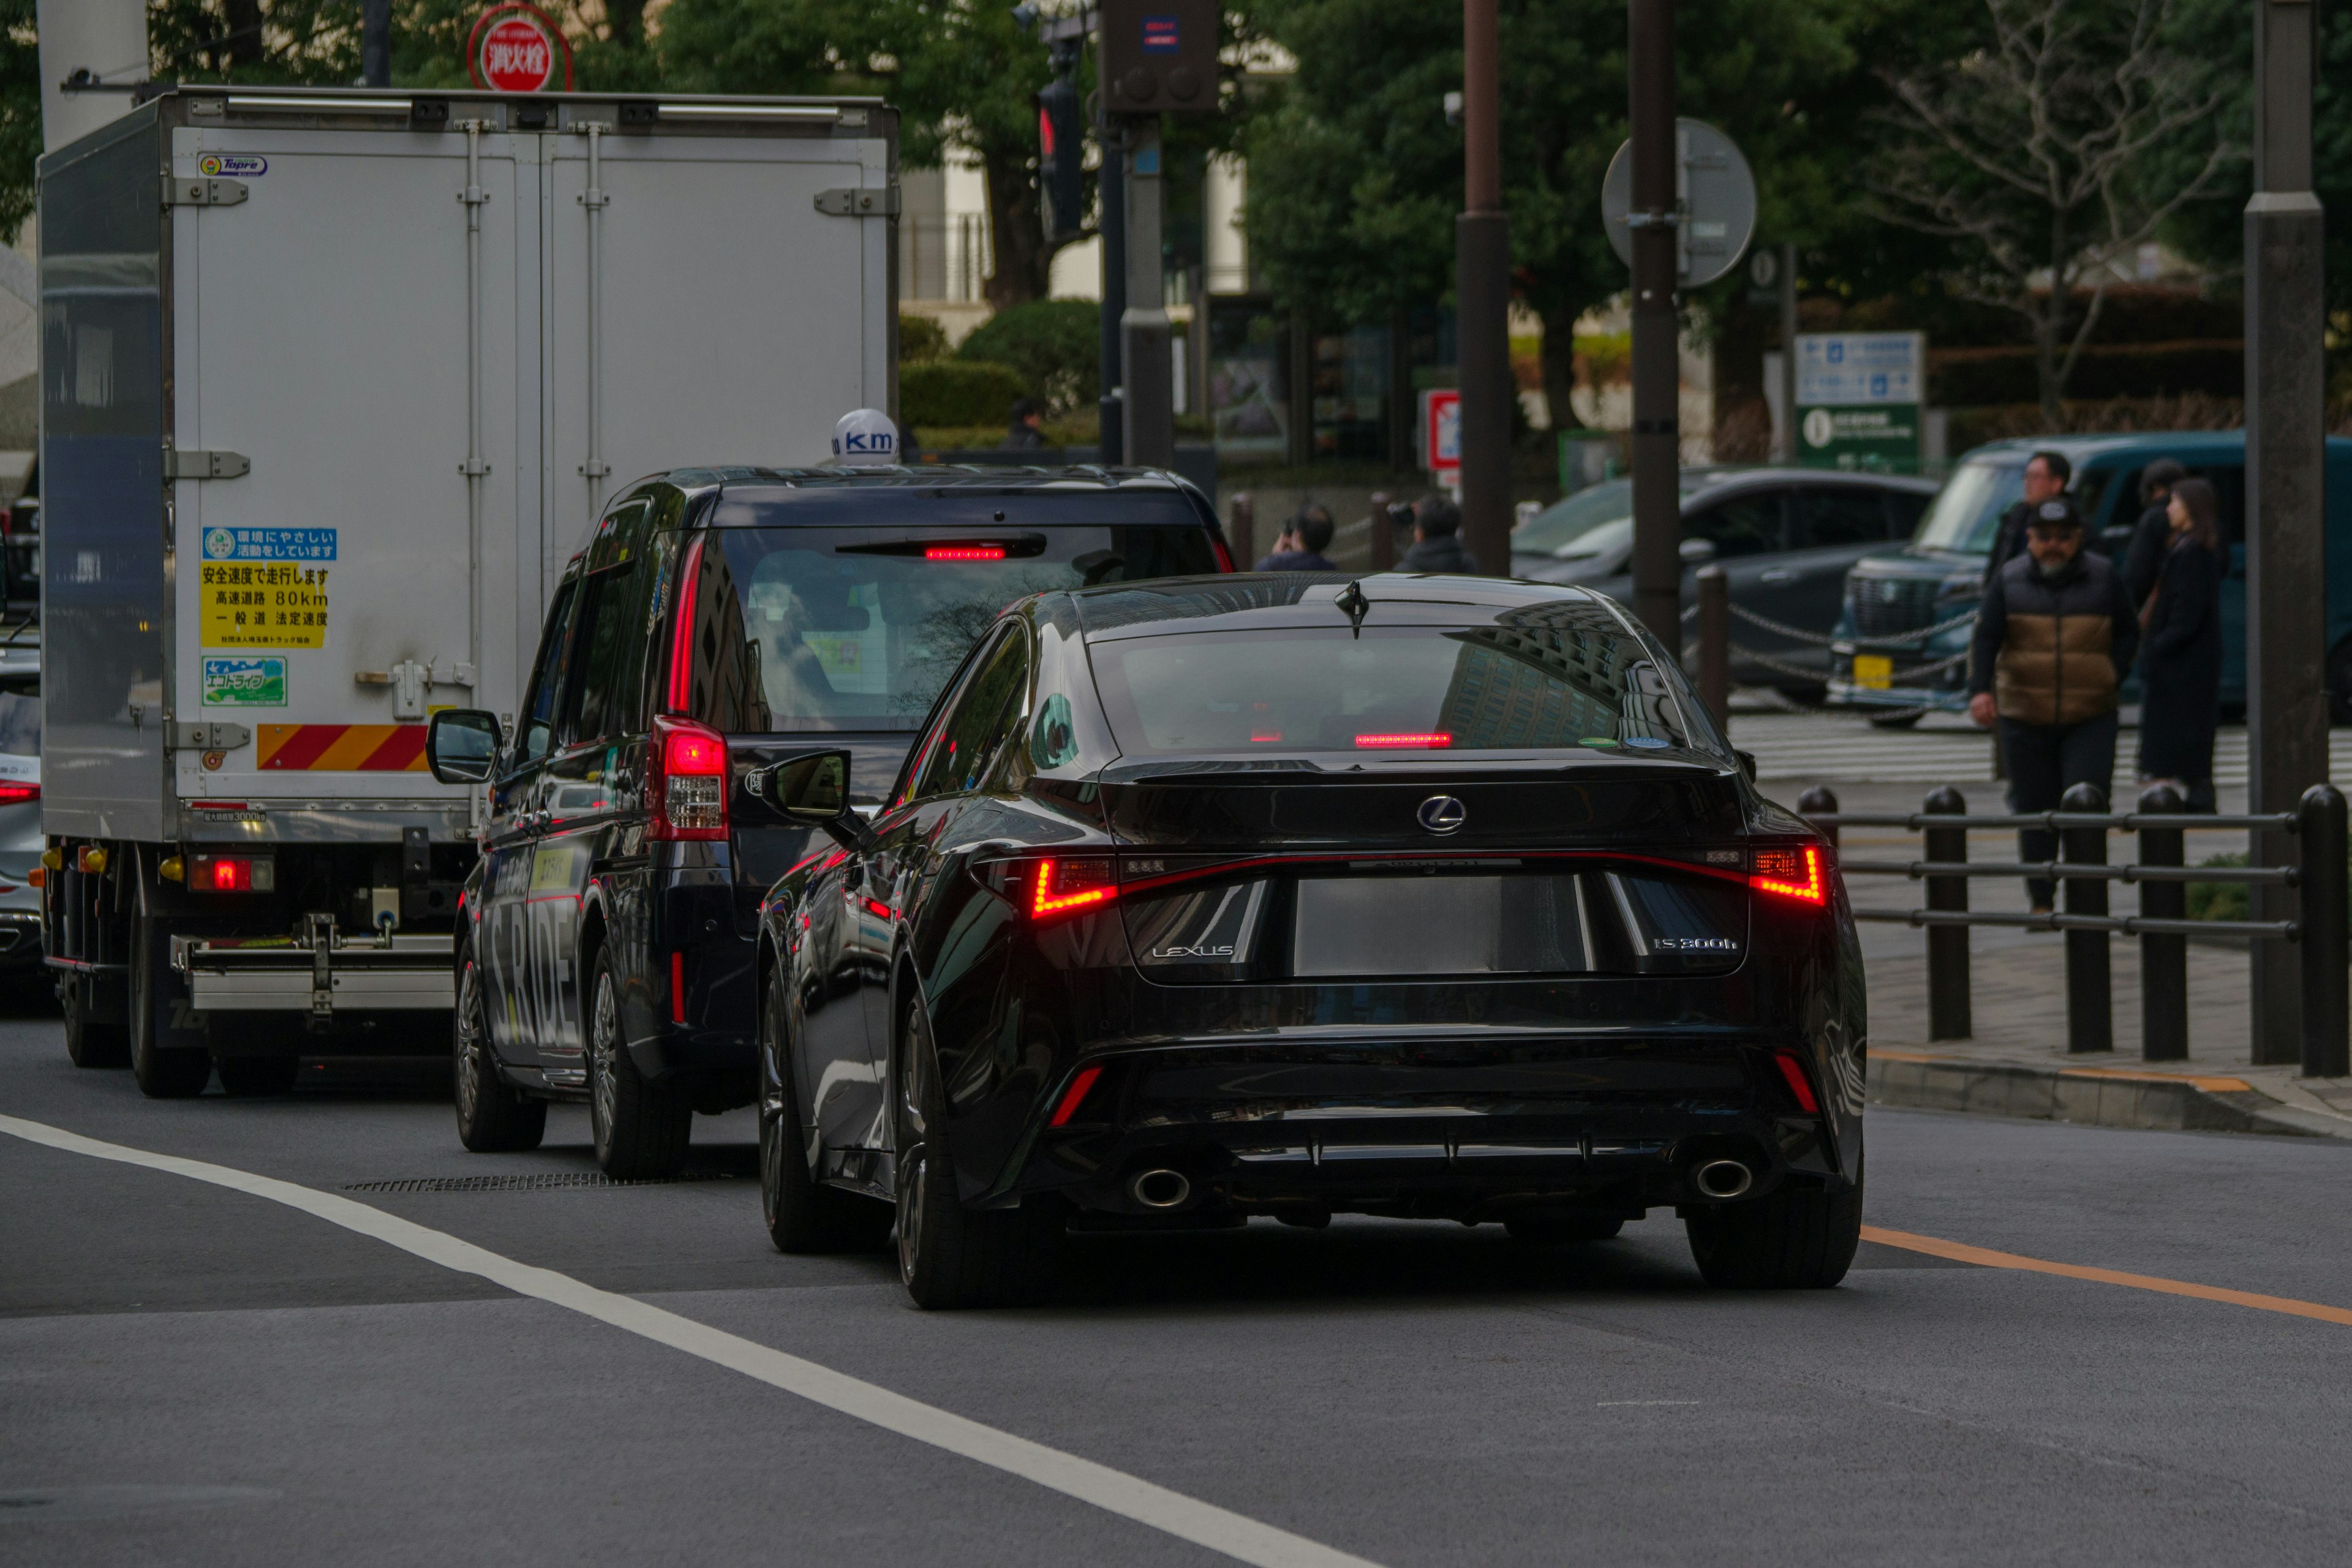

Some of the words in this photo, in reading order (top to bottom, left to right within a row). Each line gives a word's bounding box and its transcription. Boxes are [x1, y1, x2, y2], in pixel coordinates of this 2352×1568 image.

[488, 42, 545, 74] 消火栓
[224, 159, 257, 170] Topre
[237, 530, 333, 543] 環境にやさしい
[237, 545, 333, 557] 活動をしています
[203, 567, 328, 585] 安全速度で走行します
[216, 590, 265, 606] 高速道路
[276, 611, 327, 626] 法定速度
[1680, 938, 1738, 949] 300h
[1153, 946, 1233, 957] LEXUS
